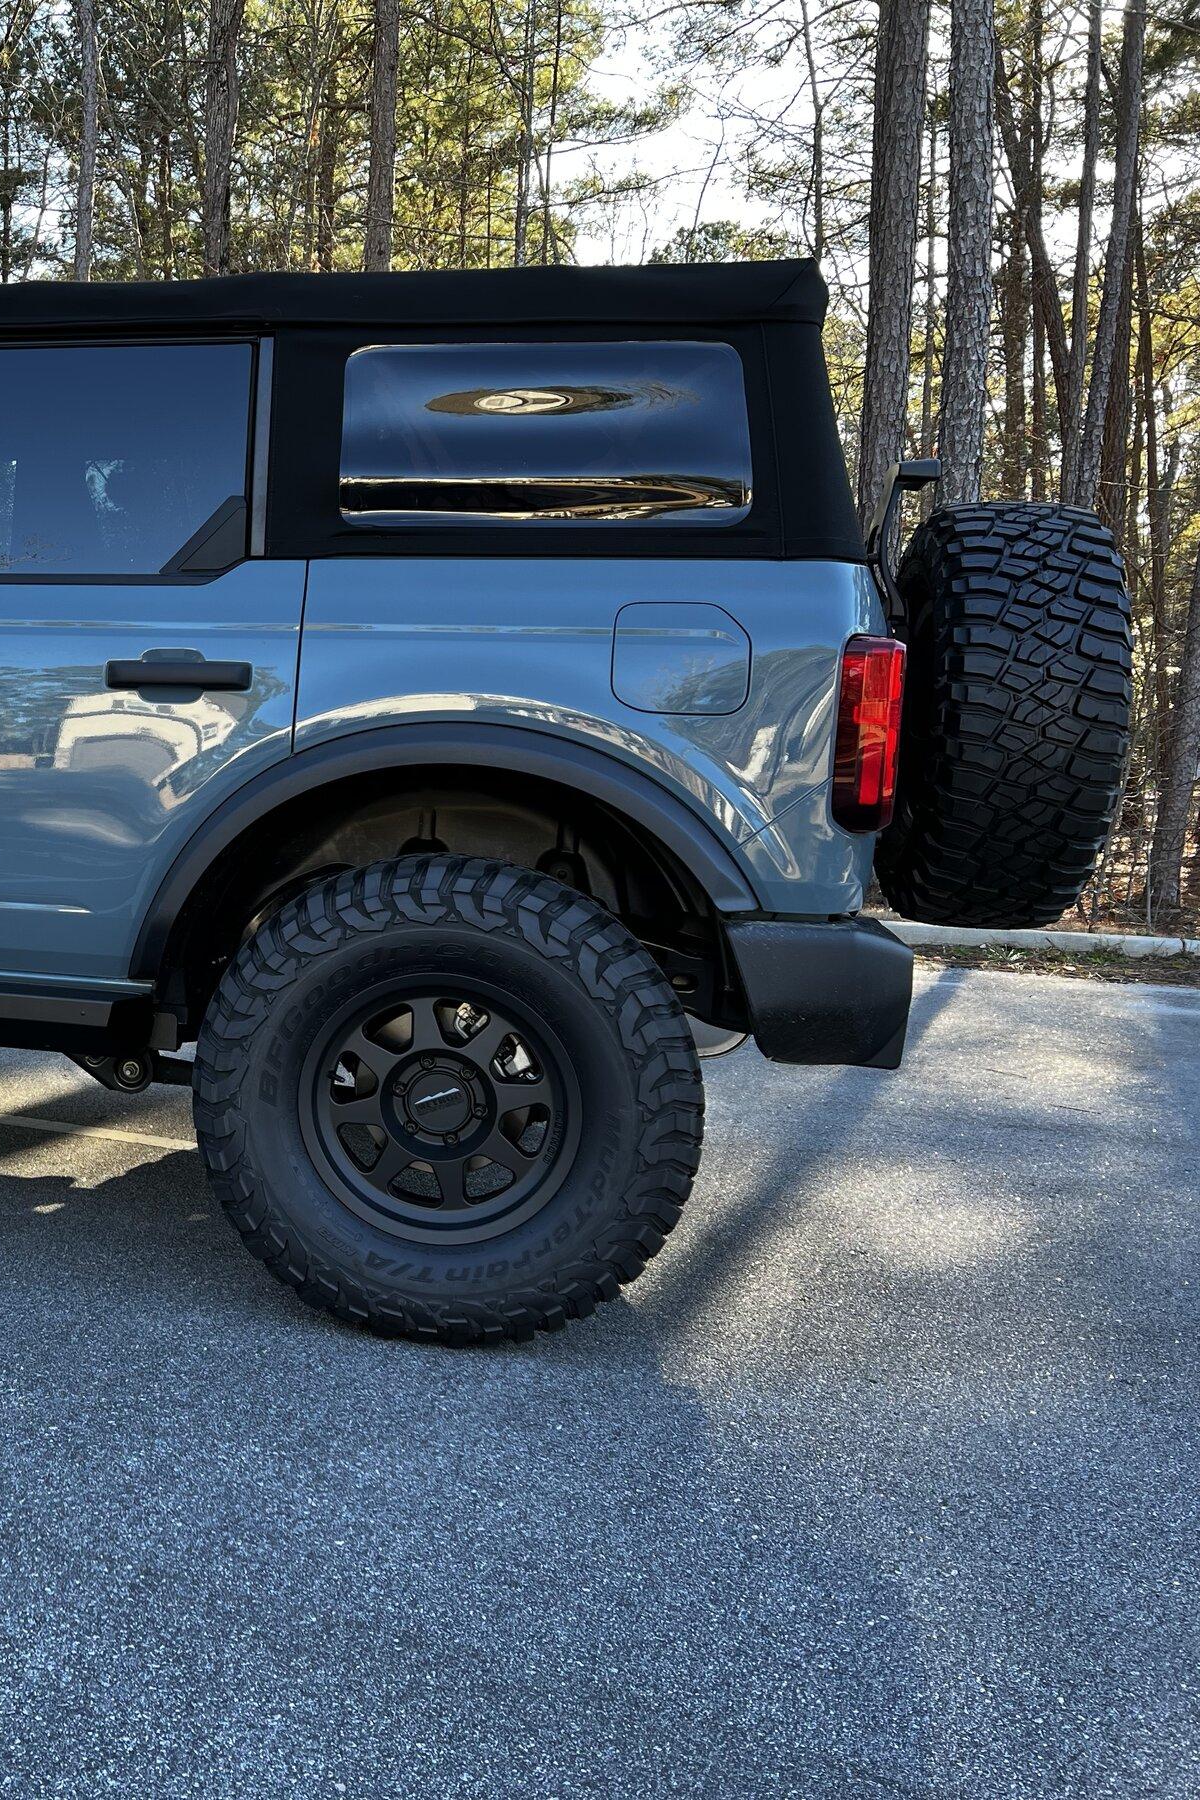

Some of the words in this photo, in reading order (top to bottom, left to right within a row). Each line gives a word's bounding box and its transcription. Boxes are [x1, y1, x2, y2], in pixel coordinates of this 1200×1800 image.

[257, 943, 503, 1107] BFGoodrich
[364, 1249, 435, 1284] T/A
[444, 1109, 622, 1284] Mud-Terrain
